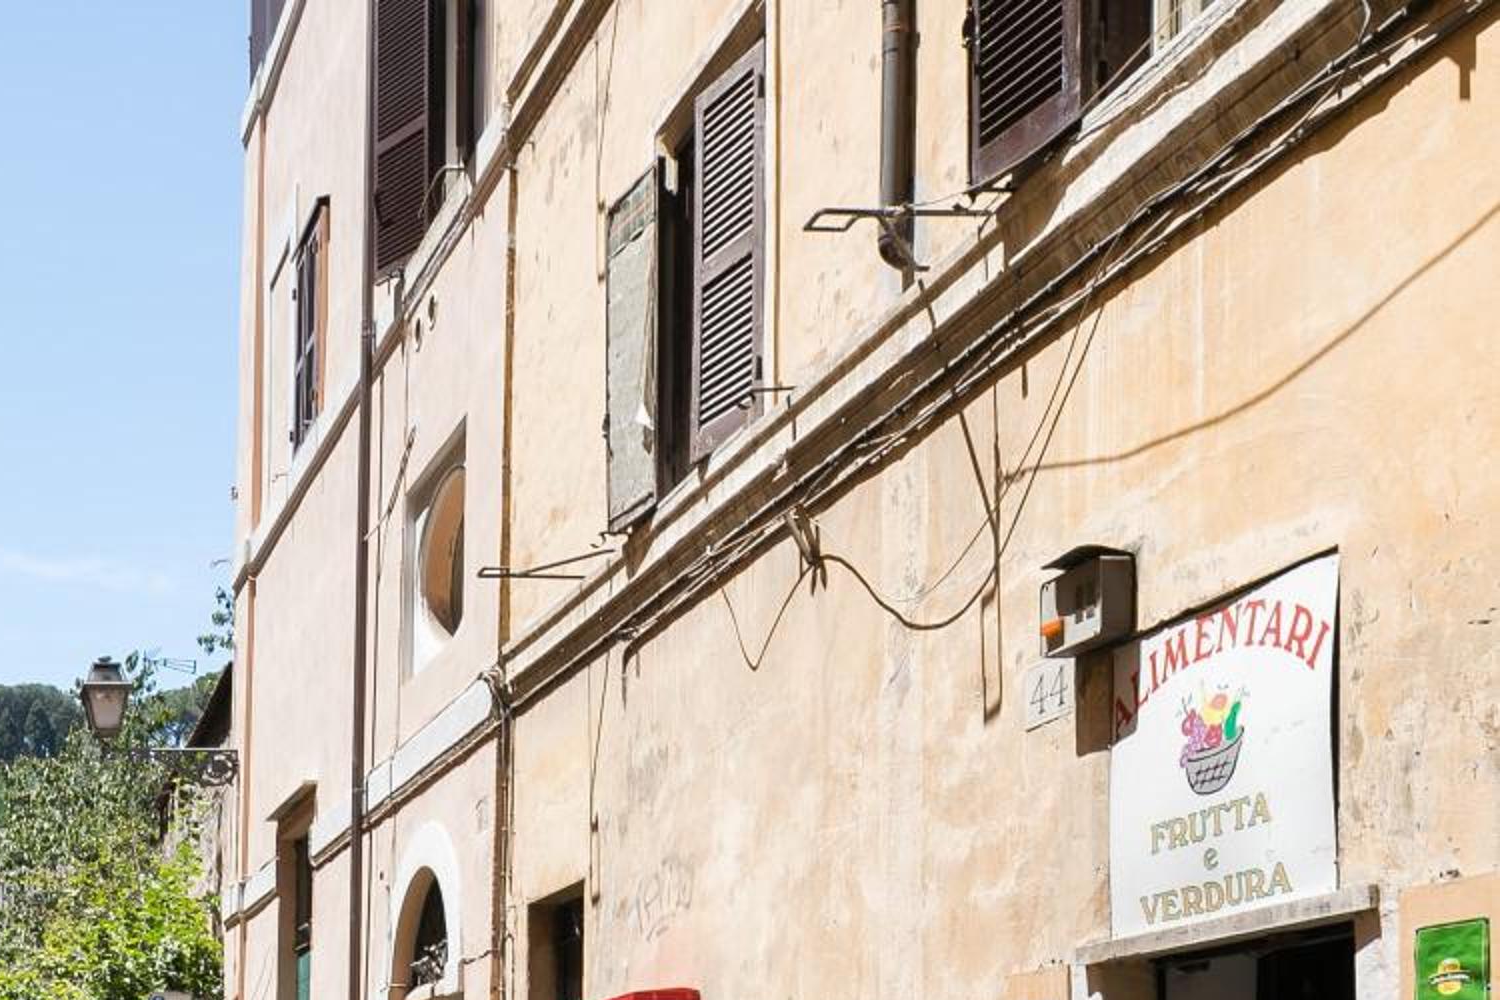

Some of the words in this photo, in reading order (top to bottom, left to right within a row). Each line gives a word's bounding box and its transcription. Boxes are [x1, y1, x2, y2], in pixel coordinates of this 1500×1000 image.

[1030, 664, 1069, 715] 44
[1112, 598, 1331, 740] ALIMENTARI
[1150, 792, 1273, 856] FRUTTA
[1203, 847, 1219, 871] e
[1140, 860, 1294, 926] VERDURA
